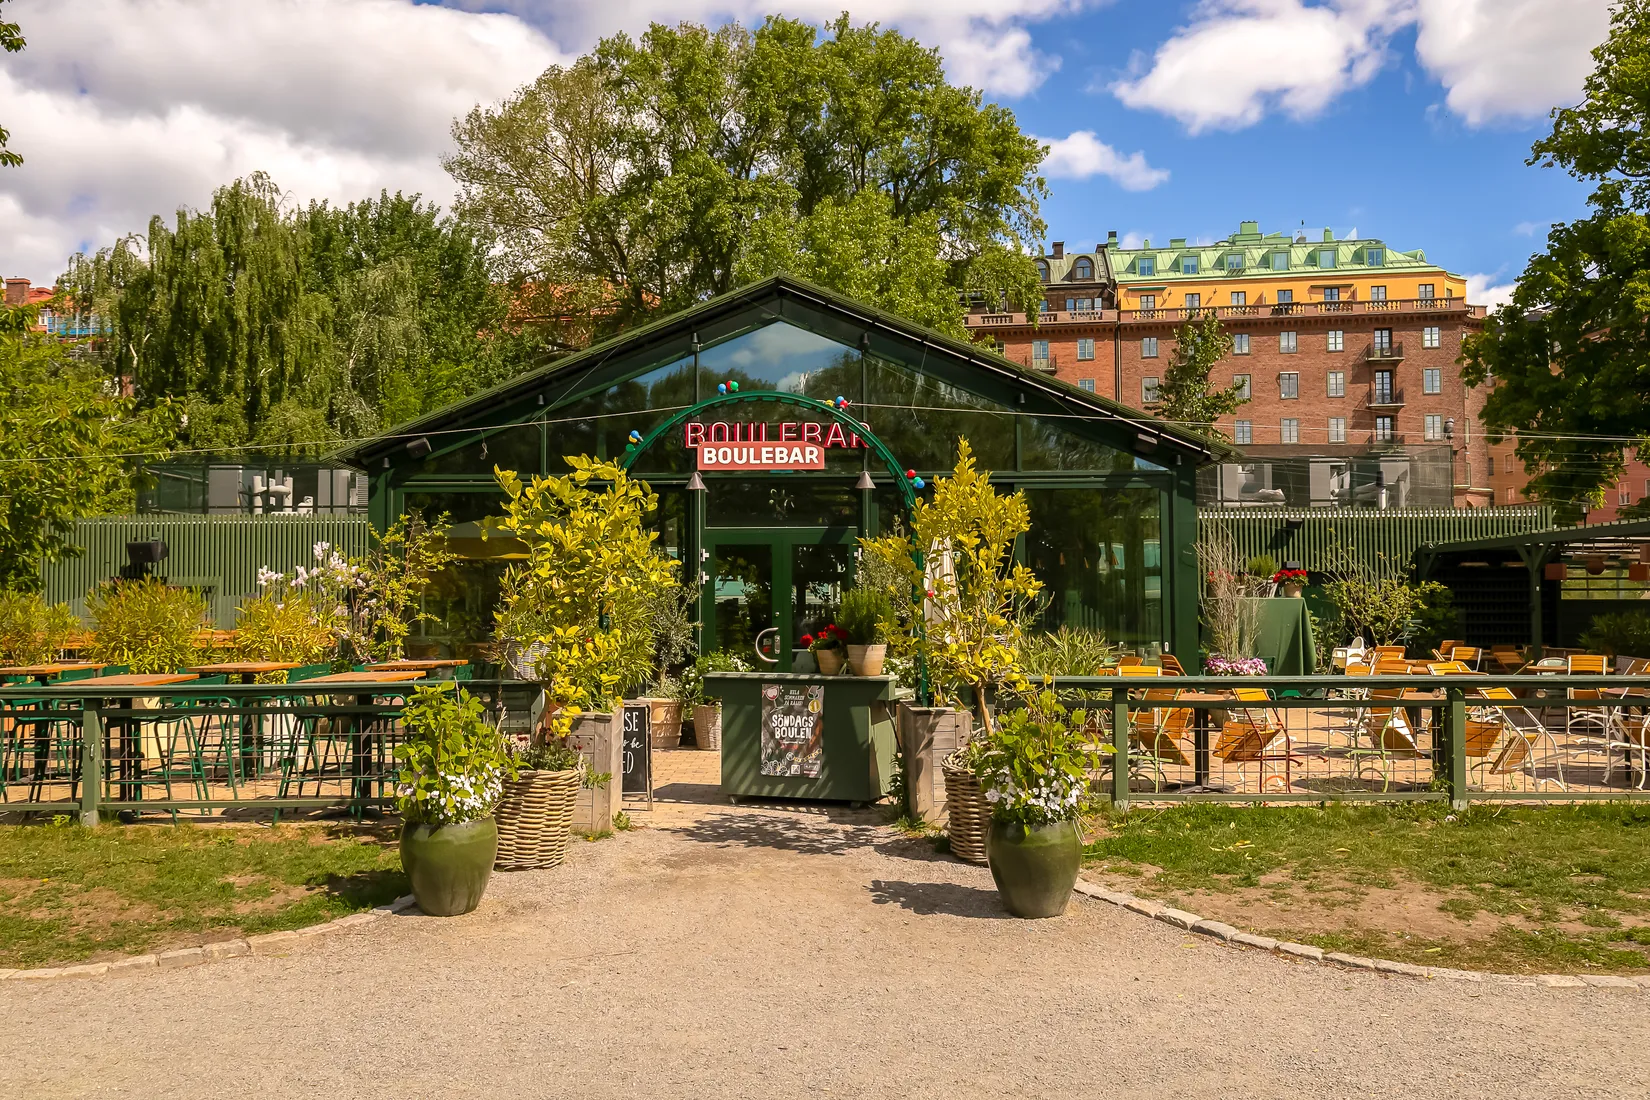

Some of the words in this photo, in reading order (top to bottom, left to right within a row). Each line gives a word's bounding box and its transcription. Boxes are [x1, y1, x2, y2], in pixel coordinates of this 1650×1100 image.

[703, 447, 819, 464] BOULEBAR
[772, 714, 814, 728] SÖNDAGS
[774, 727, 812, 739] BOULEN
[630, 737, 643, 748] be
